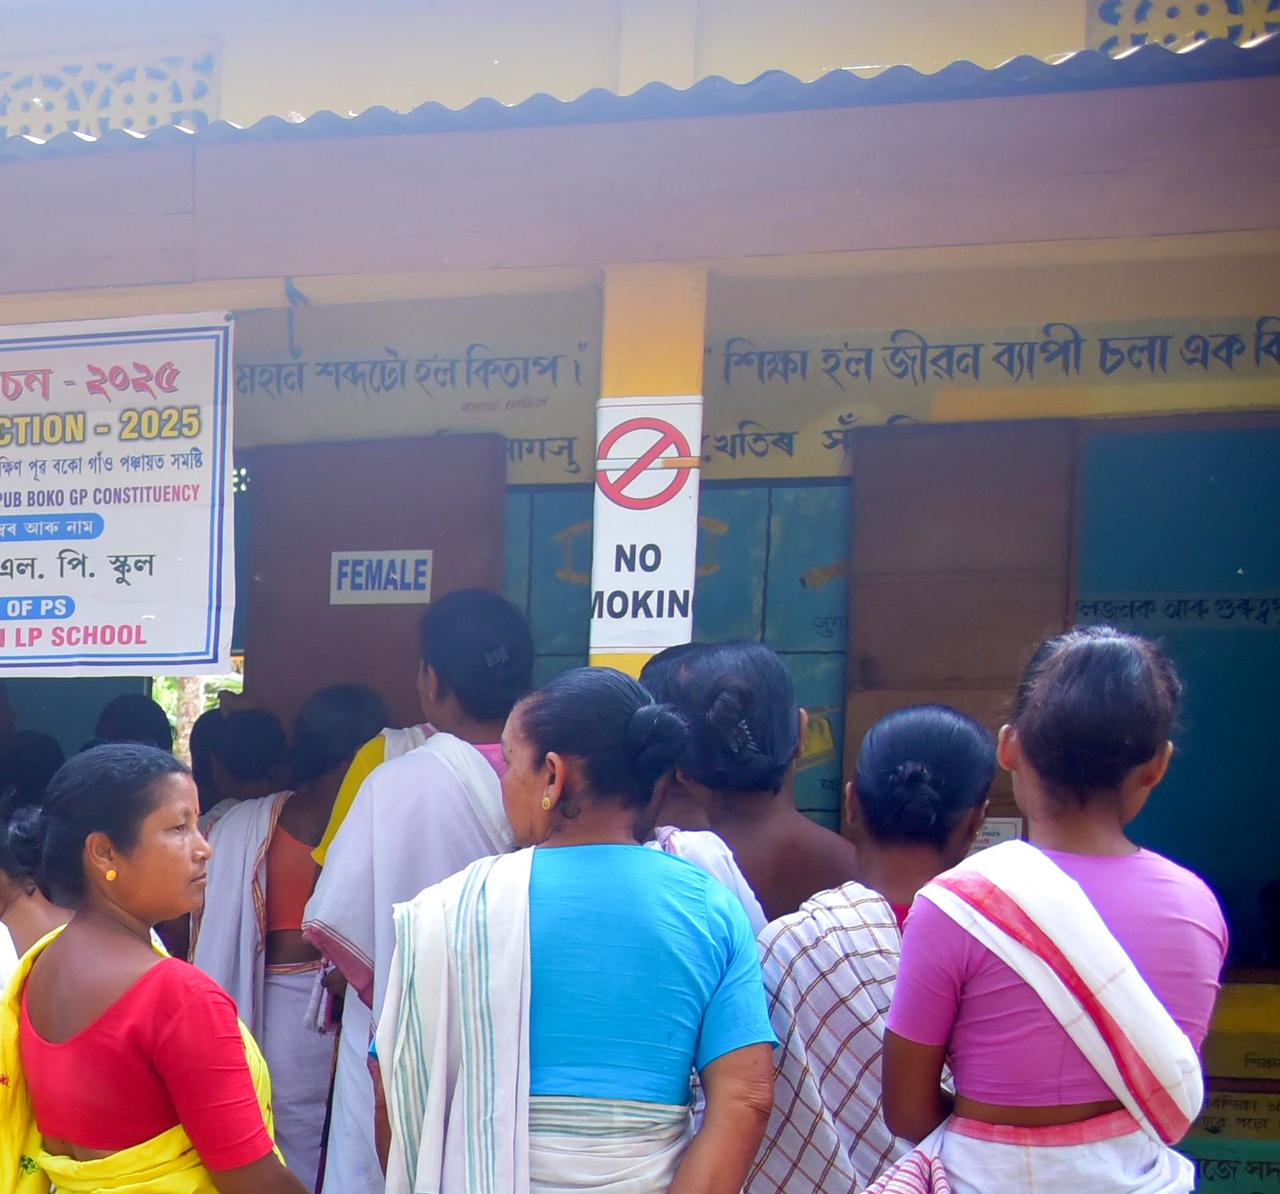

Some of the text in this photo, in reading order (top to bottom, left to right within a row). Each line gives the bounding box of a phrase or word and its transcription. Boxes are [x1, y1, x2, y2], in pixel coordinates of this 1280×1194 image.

[722, 336, 811, 388] শিক্ষা
[1096, 334, 1174, 376] চলা
[1179, 333, 1245, 371] এক
[85, 361, 182, 403] ২০২৫
[118, 407, 203, 443] 2025
[52, 456, 82, 475] বকো
[88, 450, 114, 474] গাঁও
[171, 446, 203, 470] সমষ্টি
[26, 489, 65, 507] BOKO
[69, 488, 88, 505] GP
[93, 483, 201, 505] CONSTITUENCY
[66, 519, 94, 535] নাম
[107, 554, 156, 586] স্কুল
[614, 544, 662, 573] NO
[336, 557, 428, 592] FEMALE
[6, 599, 34, 617] OF
[40, 598, 68, 616] PS
[14, 628, 43, 648] LP
[50, 624, 148, 647] SCHOOL
